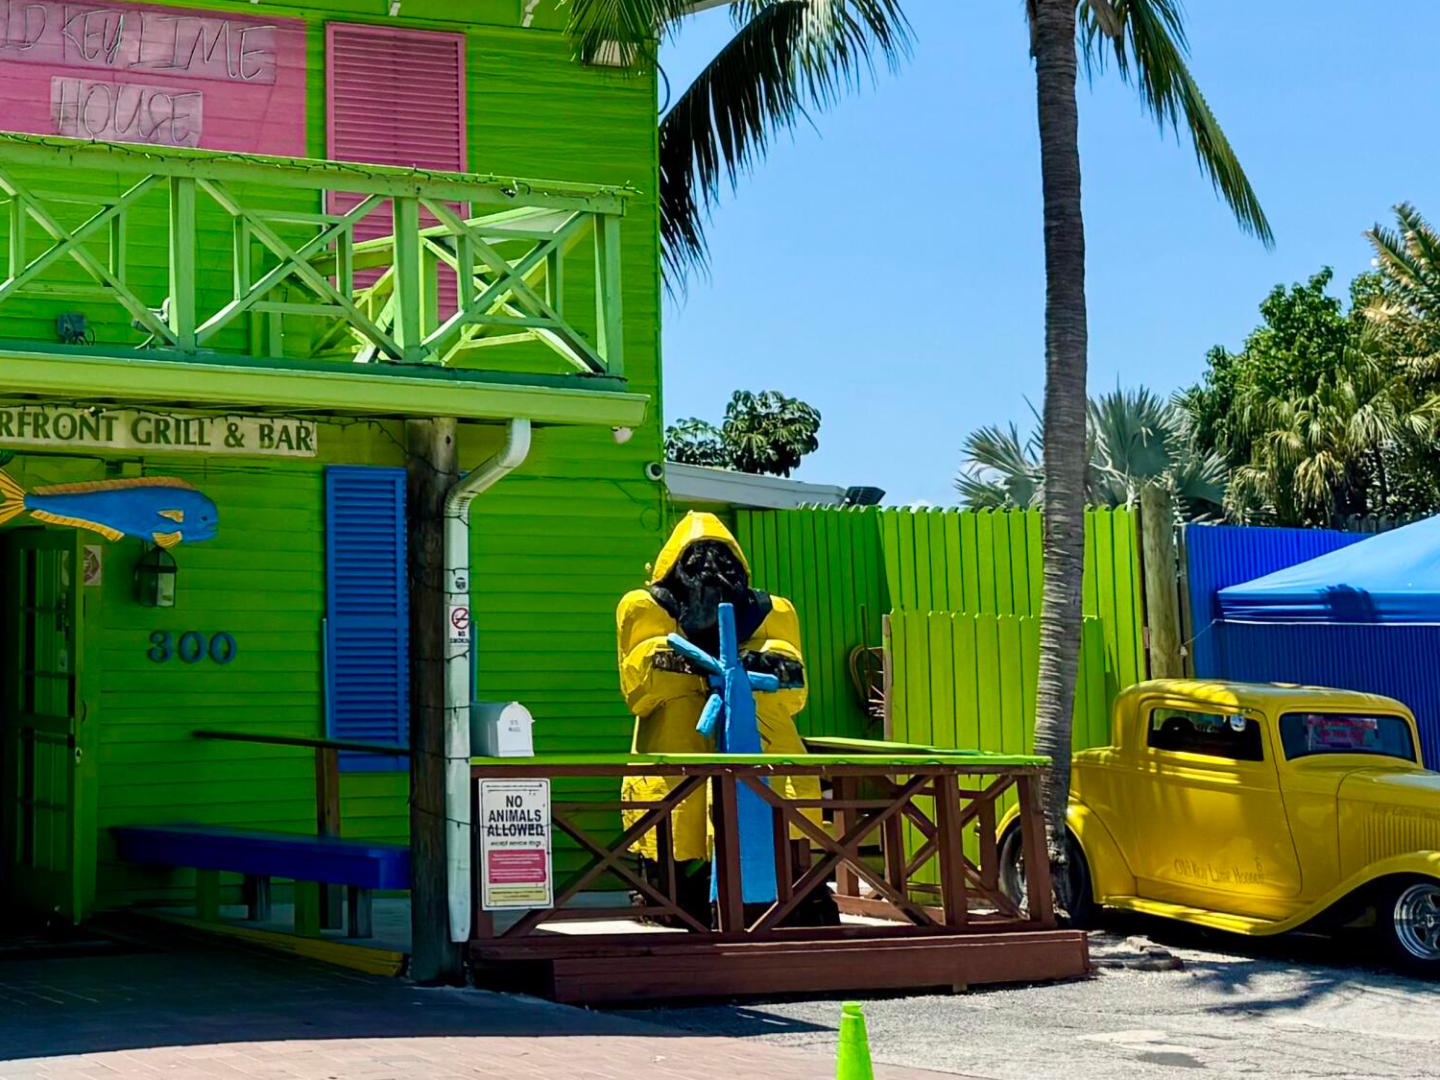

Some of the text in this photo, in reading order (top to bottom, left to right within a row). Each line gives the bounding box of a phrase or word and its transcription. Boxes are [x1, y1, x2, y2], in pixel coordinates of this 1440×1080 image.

[53, 80, 201, 144] HOUSE
[131, 416, 211, 446] GRILL
[224, 422, 245, 448] &
[259, 423, 312, 451] BAR
[147, 630, 237, 664] 300
[506, 795, 522, 807] NO
[489, 810, 541, 822] ANIMALS
[487, 824, 545, 836] ALLOWED
